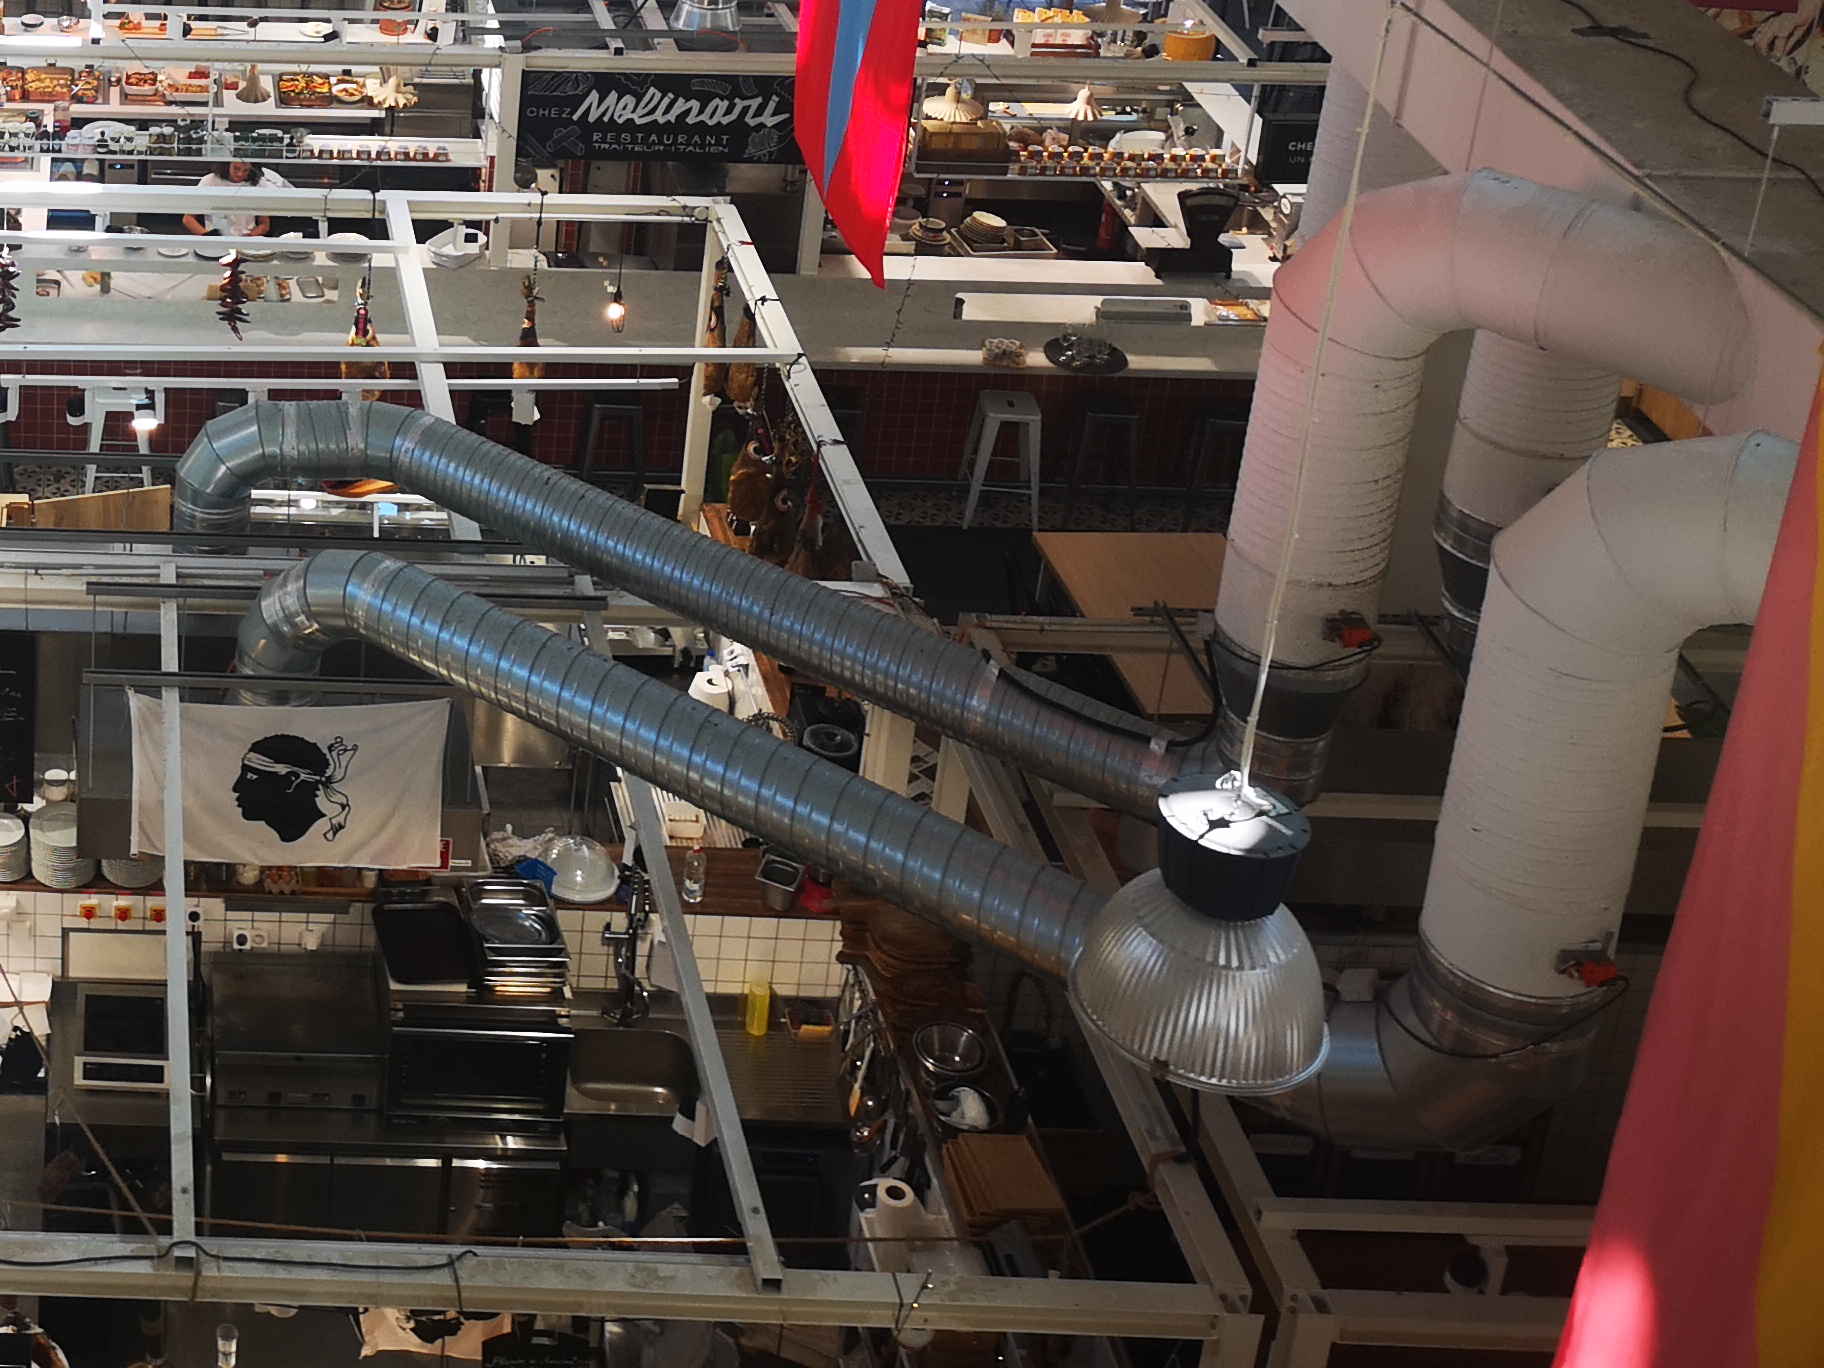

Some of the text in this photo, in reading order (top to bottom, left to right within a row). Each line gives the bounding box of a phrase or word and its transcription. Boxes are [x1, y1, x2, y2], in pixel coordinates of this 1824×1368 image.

[527, 86, 791, 127] CHEZ Molinari
[592, 132, 731, 145] RESTAURANT
[592, 143, 729, 153] TRAITEUR-ITALIEN
